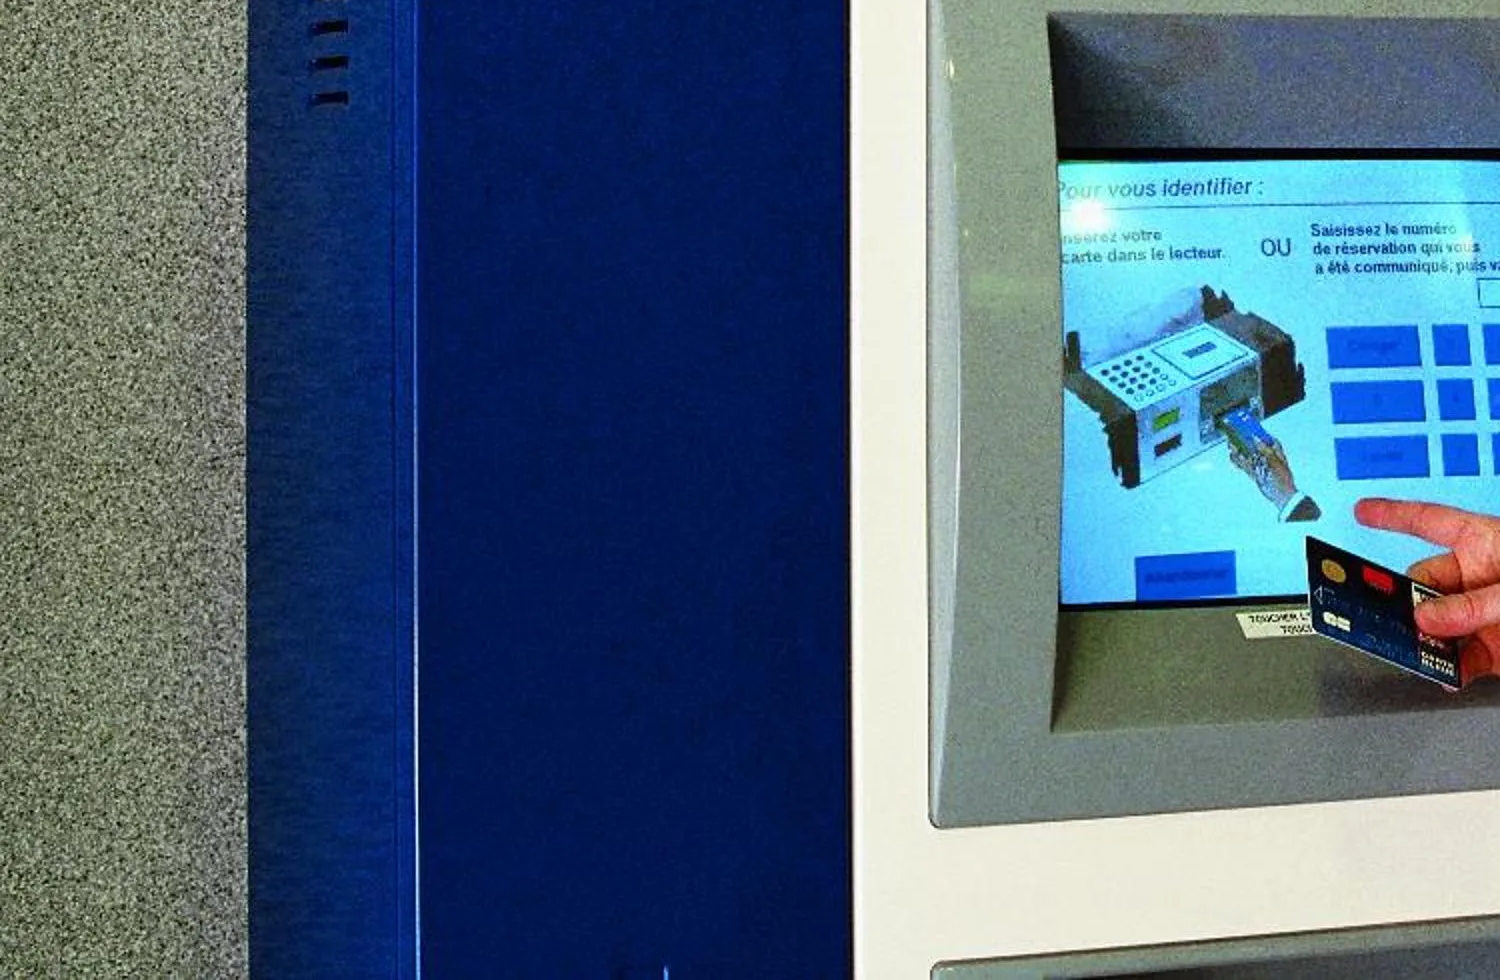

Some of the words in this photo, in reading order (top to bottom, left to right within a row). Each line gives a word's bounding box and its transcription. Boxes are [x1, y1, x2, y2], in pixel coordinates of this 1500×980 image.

[1107, 182, 1157, 198] vous
[1162, 177, 1253, 197] identifier
[1120, 229, 1163, 242] votre
[1309, 222, 1381, 237] Saisissez
[1384, 221, 1399, 235] le
[1402, 221, 1457, 235] numéro
[1061, 249, 1103, 264] carte
[1106, 247, 1147, 263] dans
[1151, 246, 1165, 261] le
[1168, 244, 1225, 260] lecteur.
[1260, 236, 1292, 258] OU
[1312, 241, 1331, 255] de
[1334, 240, 1417, 255] réservation
[1420, 241, 1443, 257] qui
[1445, 242, 1480, 253] vous
[1314, 262, 1324, 275] a
[1327, 259, 1350, 275] été
[1455, 258, 1487, 275] puis
